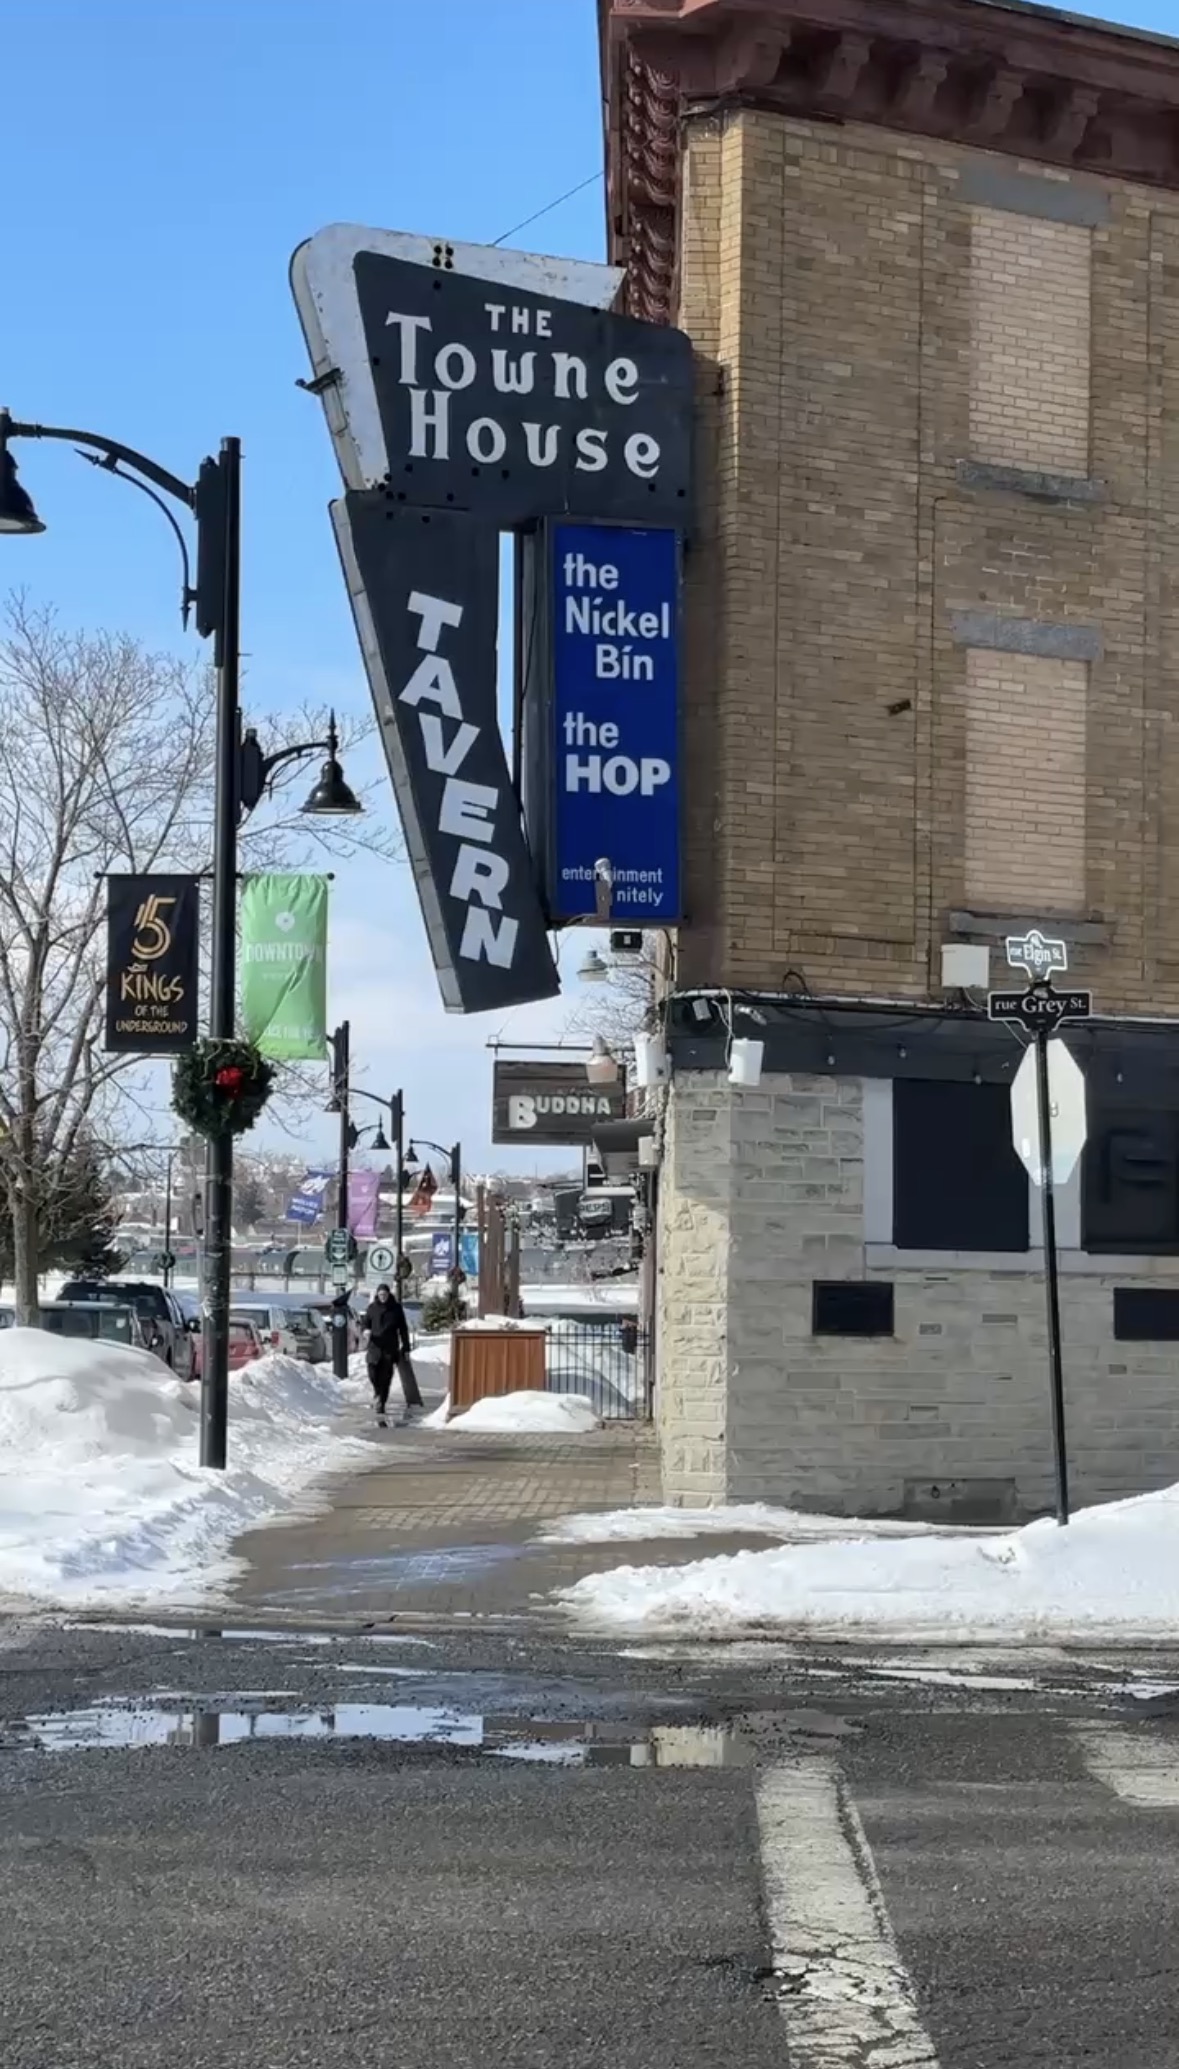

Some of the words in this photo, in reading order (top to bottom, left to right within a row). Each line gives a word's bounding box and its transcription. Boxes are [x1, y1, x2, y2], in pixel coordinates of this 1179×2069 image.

[485, 303, 552, 336] THE
[385, 312, 639, 405] Towne
[408, 388, 661, 478] House
[563, 552, 619, 590] the
[564, 596, 670, 639] Nickel
[595, 644, 654, 681] Bin
[563, 711, 619, 749] the
[399, 591, 520, 969] TAVERN
[564, 754, 671, 796] HOP
[561, 866, 663, 883] enterinment
[616, 886, 664, 905] nitely
[1023, 944, 1052, 966] Elgin
[121, 973, 185, 1002] KINGS
[133, 1005, 149, 1018] OF
[150, 1006, 169, 1018] THE
[995, 1000, 1017, 1011] rue
[1022, 996, 1067, 1016] Grey
[1070, 997, 1087, 1009] St.
[115, 1019, 188, 1034] UNDERGROUND
[508, 1094, 612, 1129] BUDDHA
